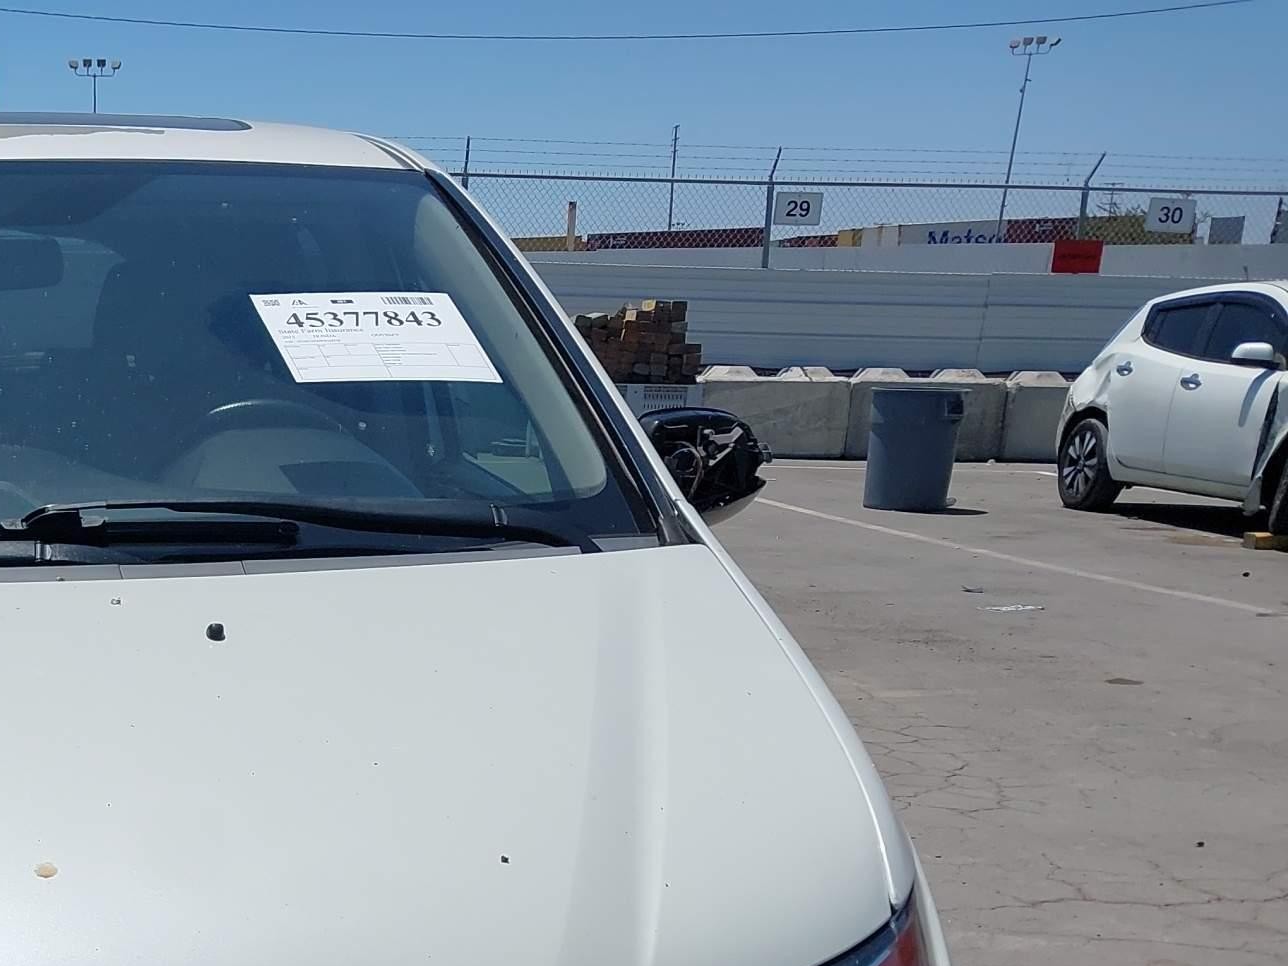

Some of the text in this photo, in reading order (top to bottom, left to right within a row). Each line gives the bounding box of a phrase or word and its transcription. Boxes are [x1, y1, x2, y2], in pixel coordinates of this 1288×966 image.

[785, 200, 811, 218] 29
[1158, 206, 1184, 224] 30
[286, 310, 443, 328] 45377843
